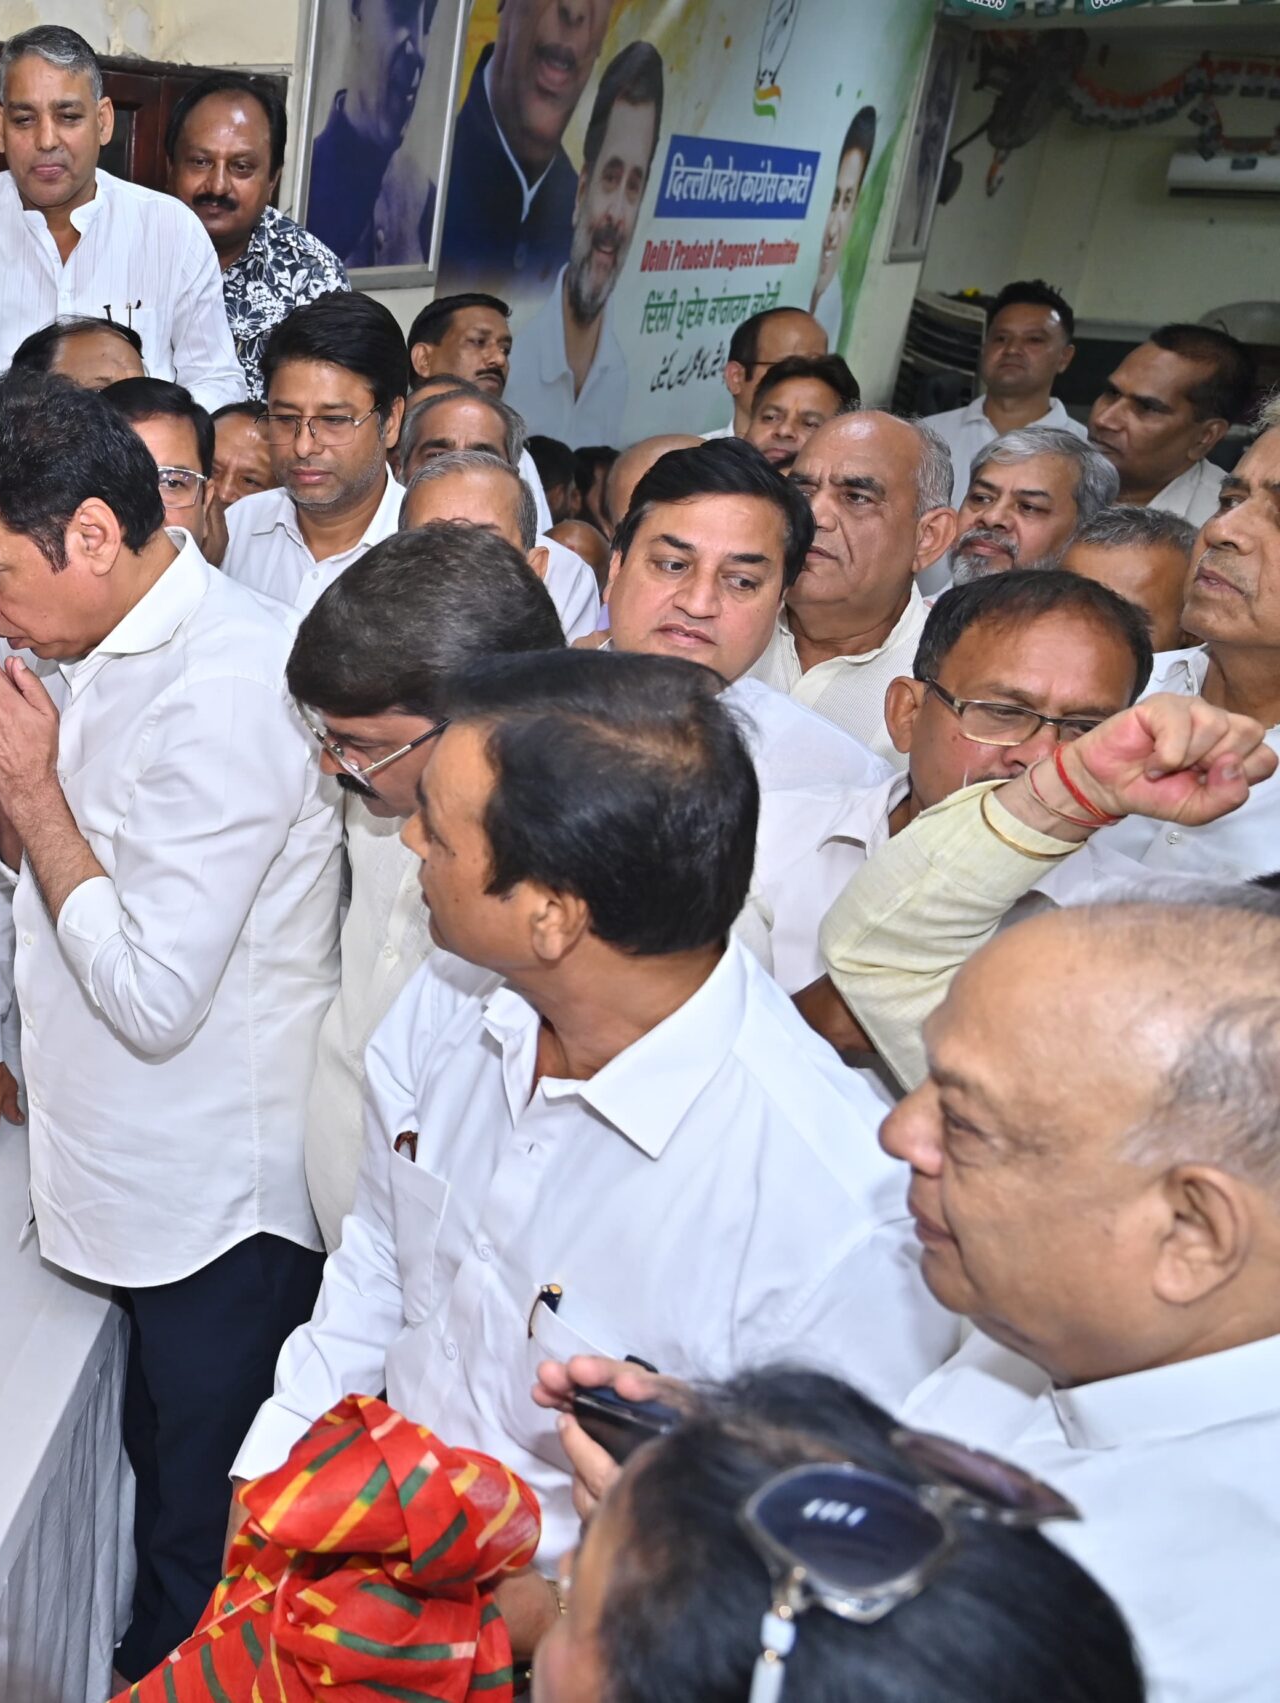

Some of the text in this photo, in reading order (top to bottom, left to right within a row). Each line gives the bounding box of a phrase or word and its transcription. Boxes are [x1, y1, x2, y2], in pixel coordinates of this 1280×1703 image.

[665, 152, 713, 202] दिल्ली
[640, 237, 800, 272] Delhi Pradesh Congress Committee
